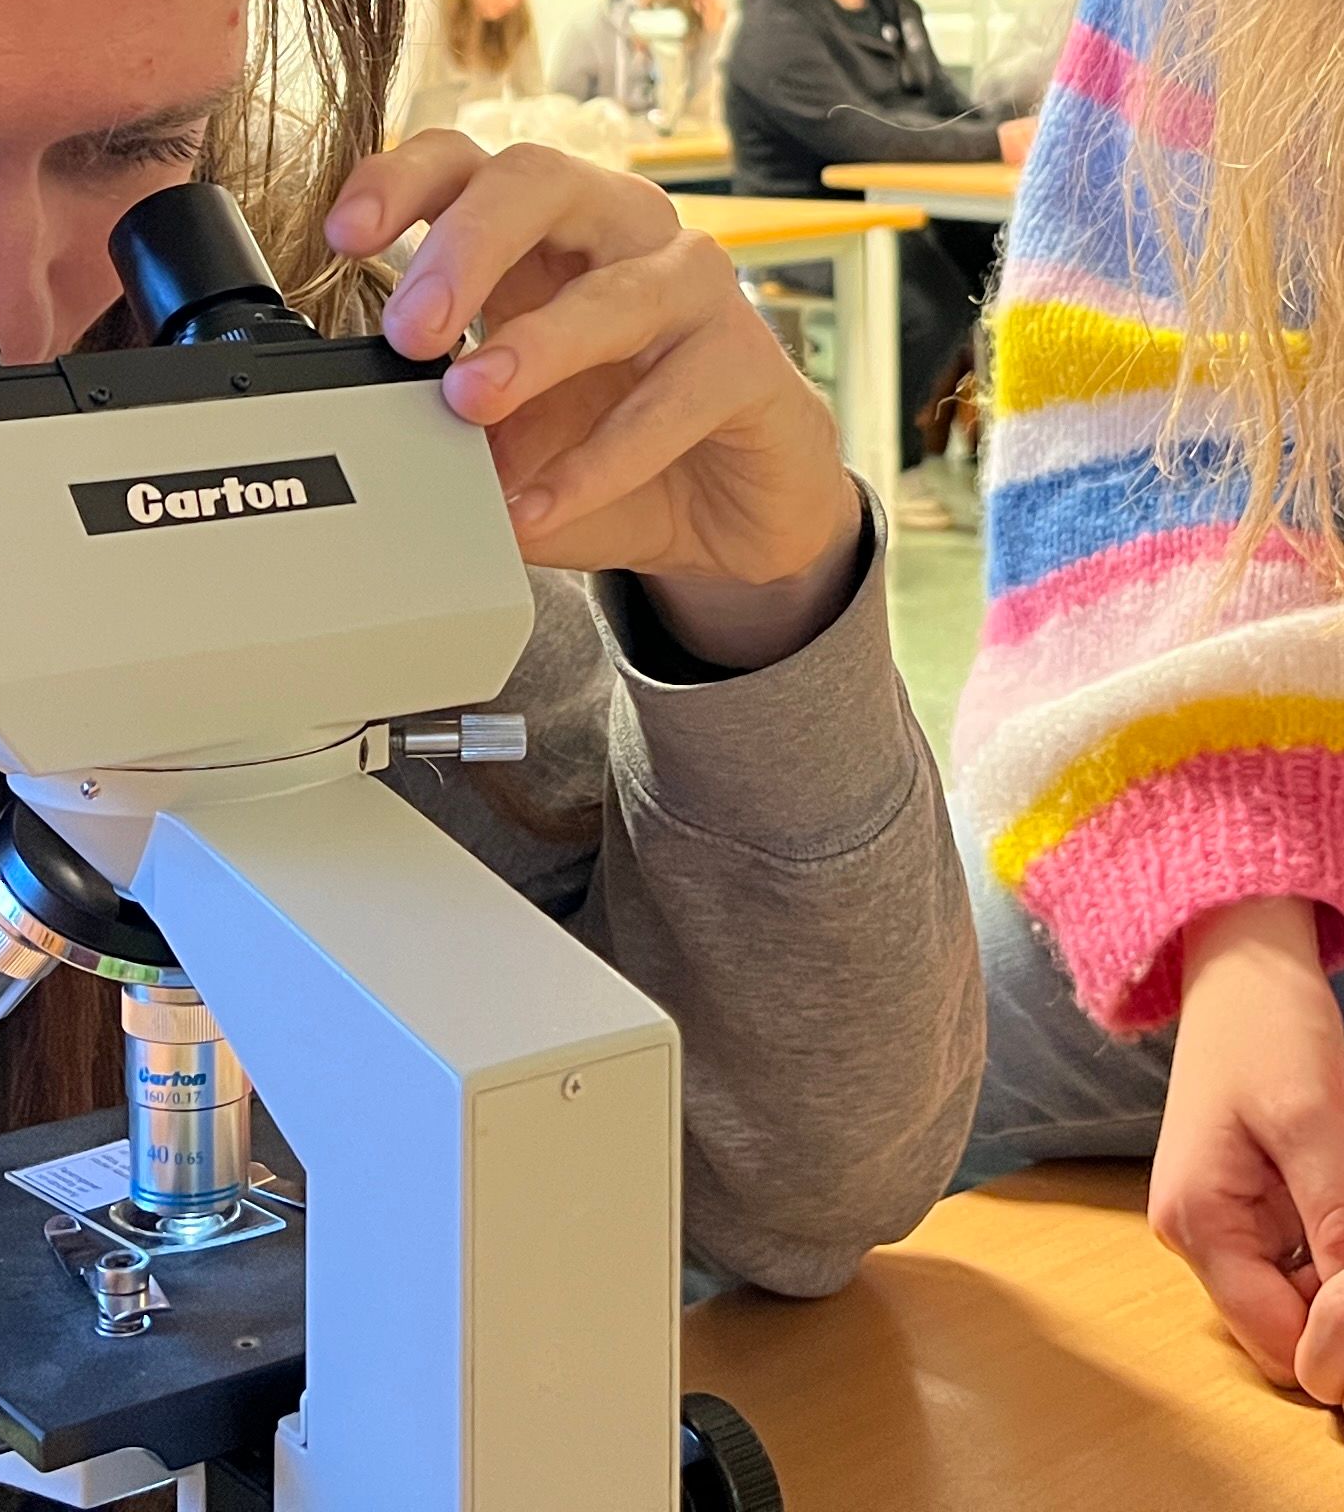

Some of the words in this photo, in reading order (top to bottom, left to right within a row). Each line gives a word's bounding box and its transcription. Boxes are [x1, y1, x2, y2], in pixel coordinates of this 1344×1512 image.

[126, 476, 309, 524] Carton
[138, 1066, 207, 1087] Carton
[143, 1090, 202, 1105] 160/0.17
[173, 1151, 205, 1165] 065
